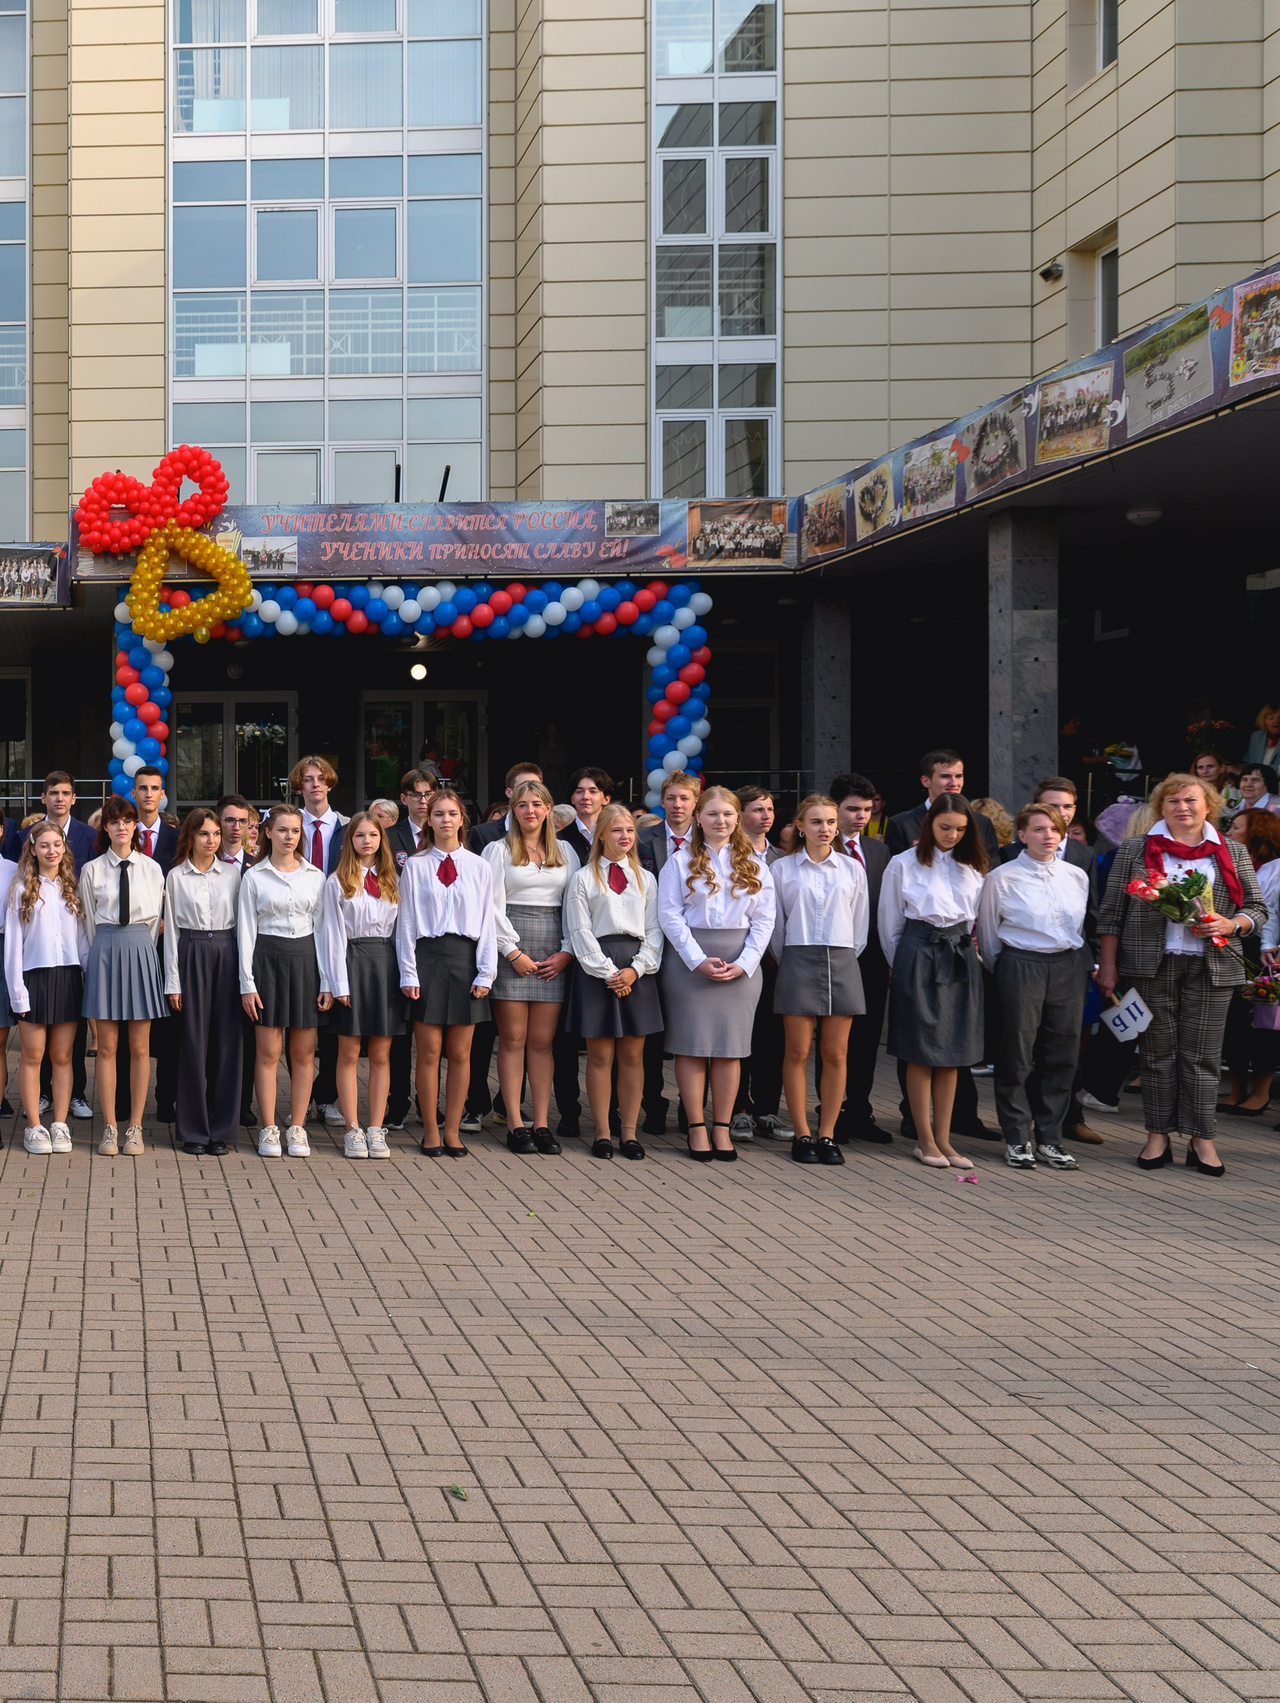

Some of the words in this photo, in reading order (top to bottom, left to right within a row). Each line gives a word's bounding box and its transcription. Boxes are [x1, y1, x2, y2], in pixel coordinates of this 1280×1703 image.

[261, 513, 405, 533] УЧИТЕЛЯМИ
[408, 514, 509, 532] СЛАВИТСЯ
[511, 510, 599, 532] РОССИЯ,
[321, 541, 424, 561] УЧЕНИКИ
[428, 542, 530, 560] ПРИНОСЯТ
[530, 541, 597, 559] СЛАВУ
[598, 538, 630, 558] ЕЙ!
[1124, 1000, 1145, 1022] 11
[1111, 1013, 1130, 1033] Б
